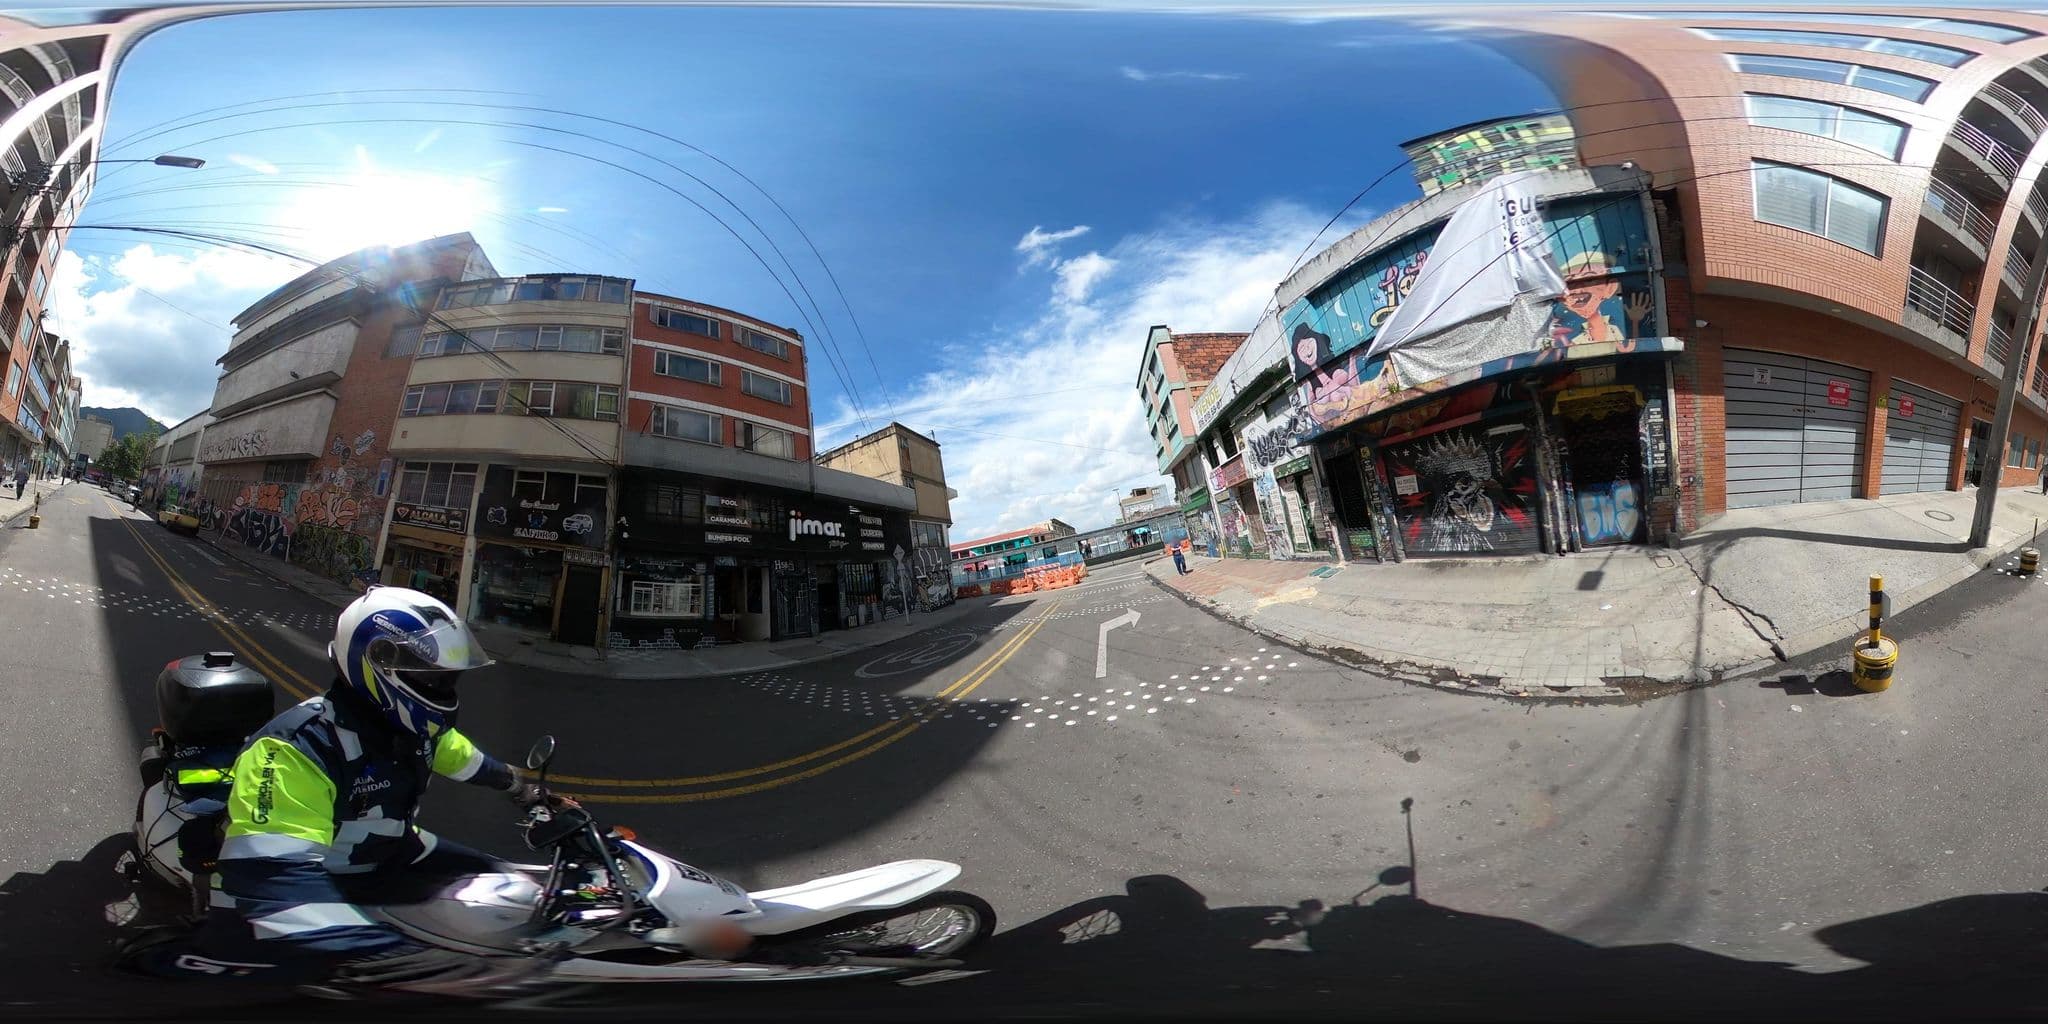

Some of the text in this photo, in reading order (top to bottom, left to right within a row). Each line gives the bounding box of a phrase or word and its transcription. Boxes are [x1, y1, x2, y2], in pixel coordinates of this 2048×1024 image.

[720, 499, 738, 507] POOL
[710, 516, 748, 525] CARAMBOLA
[708, 534, 733, 542] BUMPER
